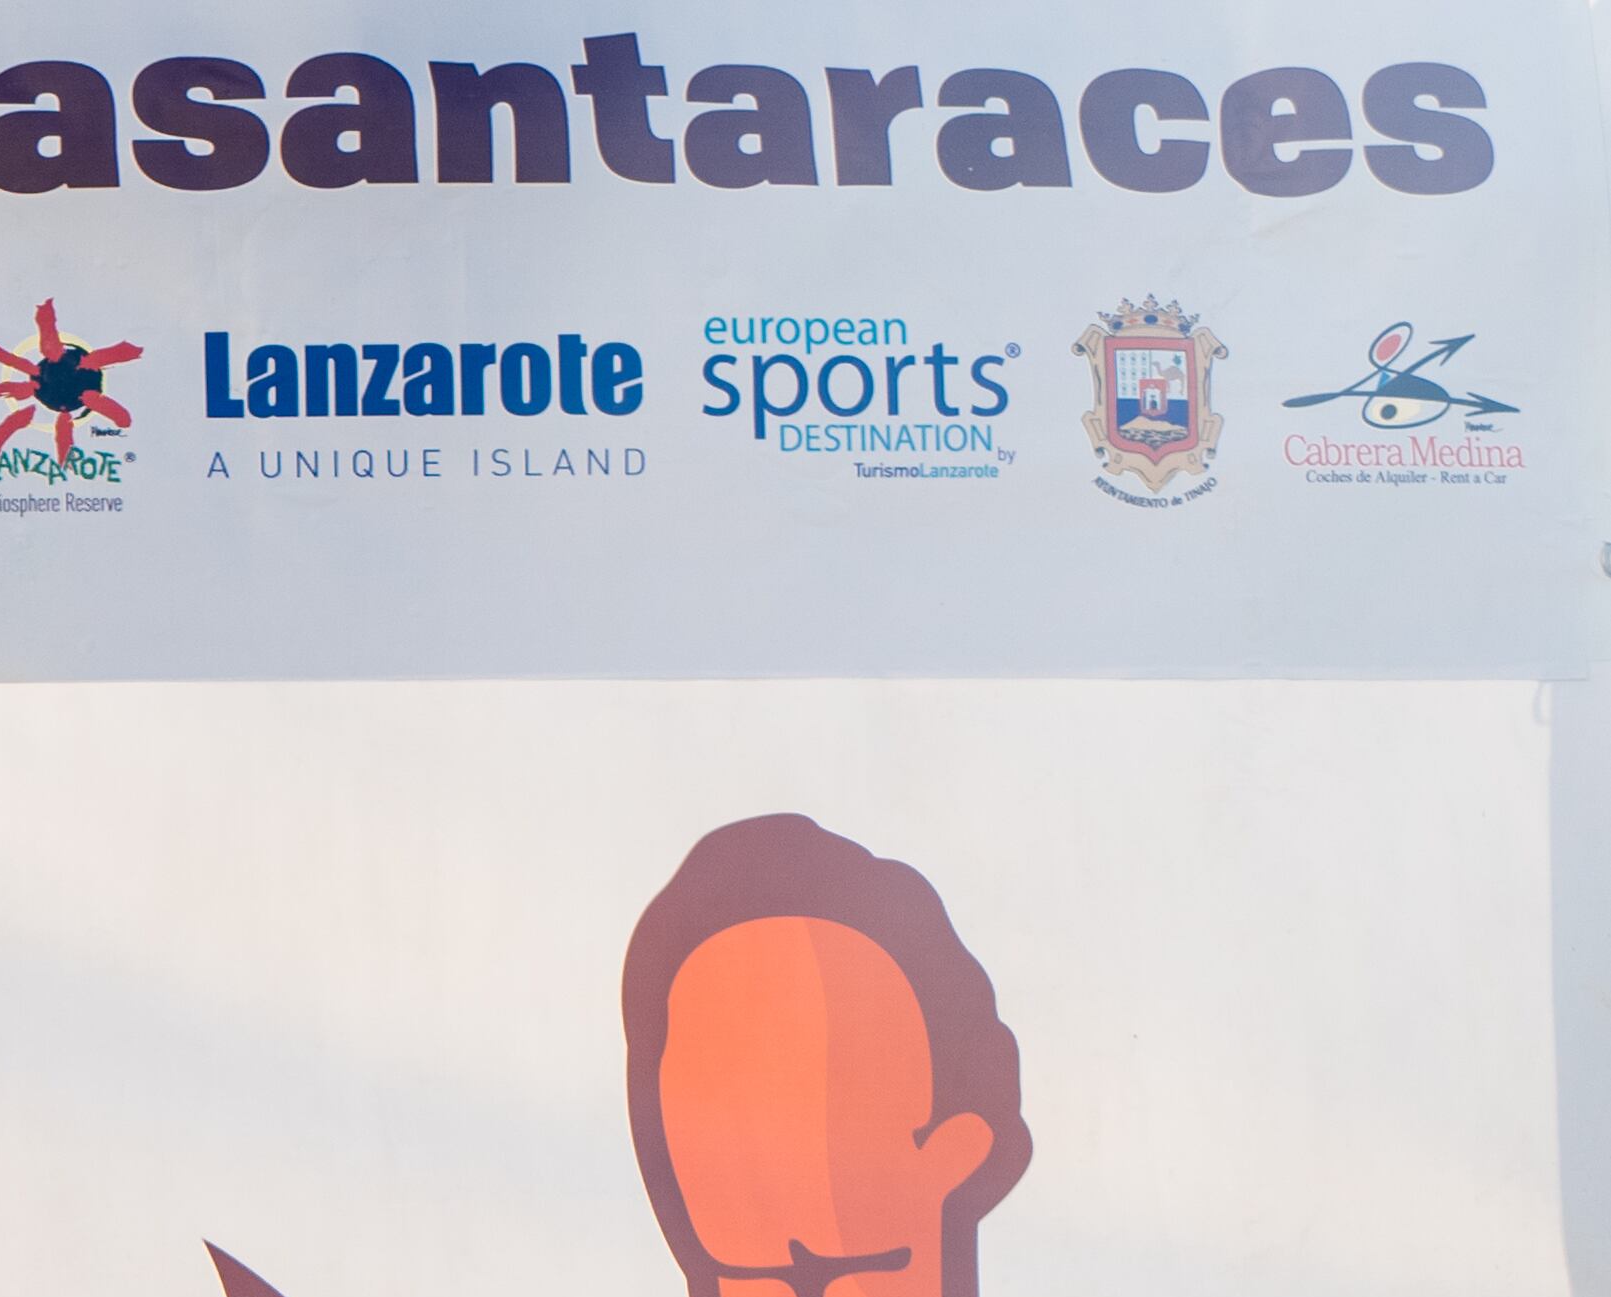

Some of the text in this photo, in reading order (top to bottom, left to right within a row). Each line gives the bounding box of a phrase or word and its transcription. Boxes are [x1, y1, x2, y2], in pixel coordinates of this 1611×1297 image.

[704, 316, 908, 354] european
[204, 332, 644, 418] Lanzarote
[702, 343, 1010, 440] sports
[779, 424, 993, 451] DESTINATION
[1282, 435, 1526, 468] Cabrera Medina
[207, 448, 647, 478] A UNIQUE ISLAND
[854, 462, 999, 479] TurismoLanzarote
[997, 447, 1016, 464] by
[1091, 476, 1168, 508] AYUNTAMIENTO
[1171, 496, 1183, 506] de
[1306, 470, 1353, 484] Coches
[1356, 470, 1372, 484] de
[1375, 470, 1427, 488] Alquiler
[1440, 472, 1470, 485] Rent
[1484, 472, 1507, 485] Car
[65, 493, 123, 513] Reserve
